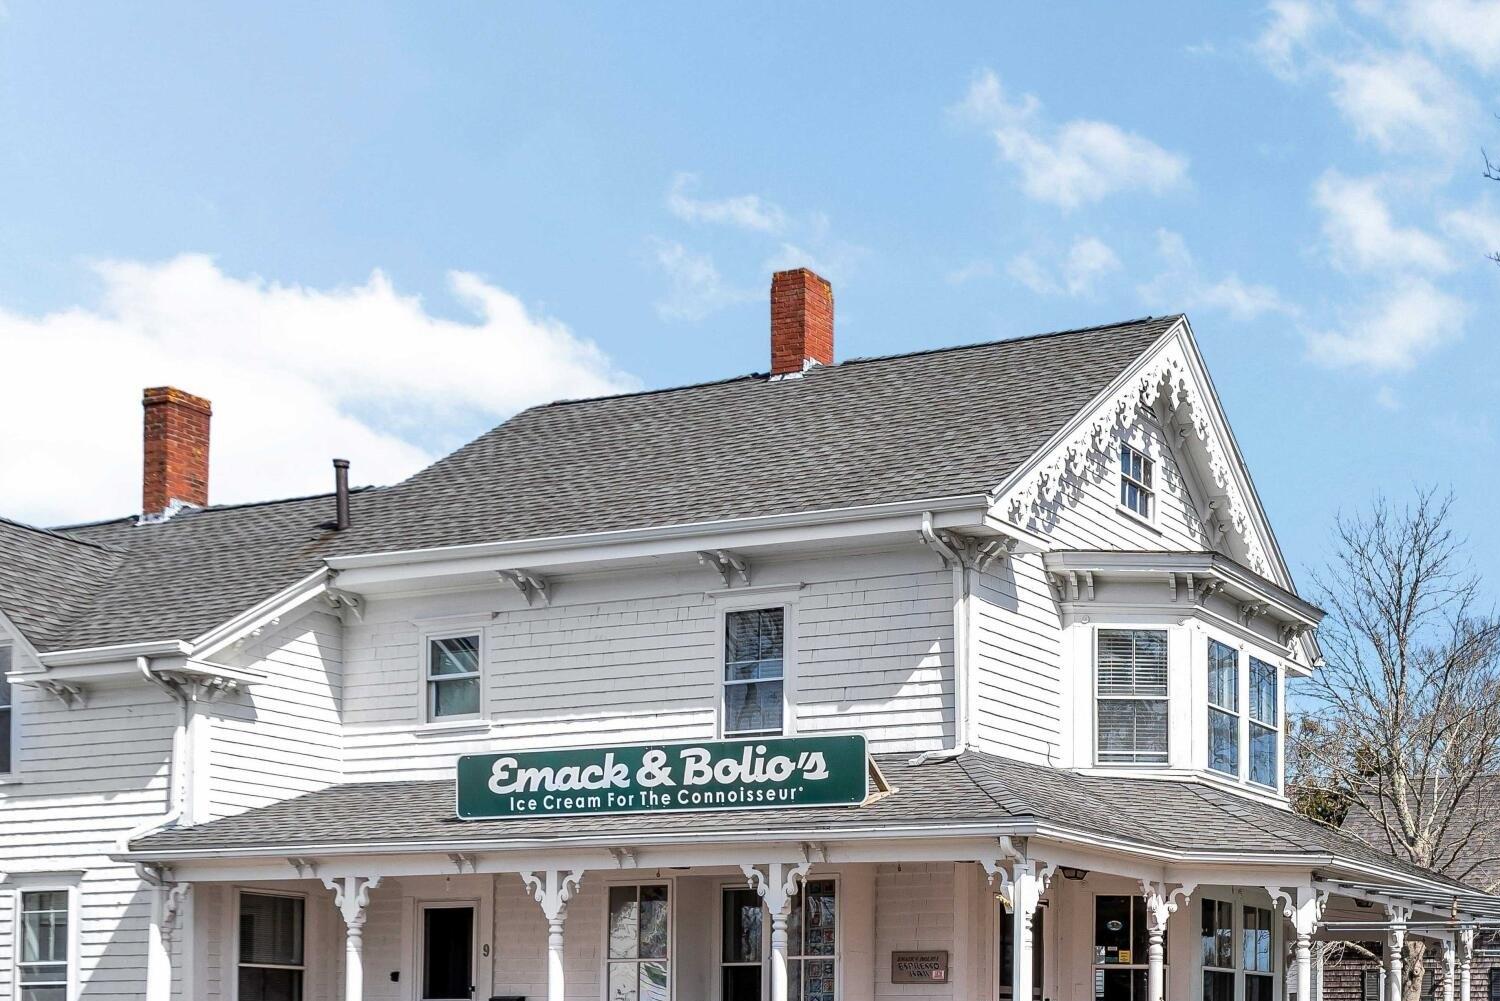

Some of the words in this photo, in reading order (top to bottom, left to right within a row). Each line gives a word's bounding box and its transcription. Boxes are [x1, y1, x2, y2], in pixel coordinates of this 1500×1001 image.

[487, 752, 631, 795] Emack
[635, 749, 677, 788] &
[679, 744, 830, 786] Bolio's
[510, 796, 537, 812] Ice
[543, 794, 601, 811] Cream
[607, 792, 635, 808] For
[639, 790, 671, 806] The
[483, 943, 490, 957] 9
